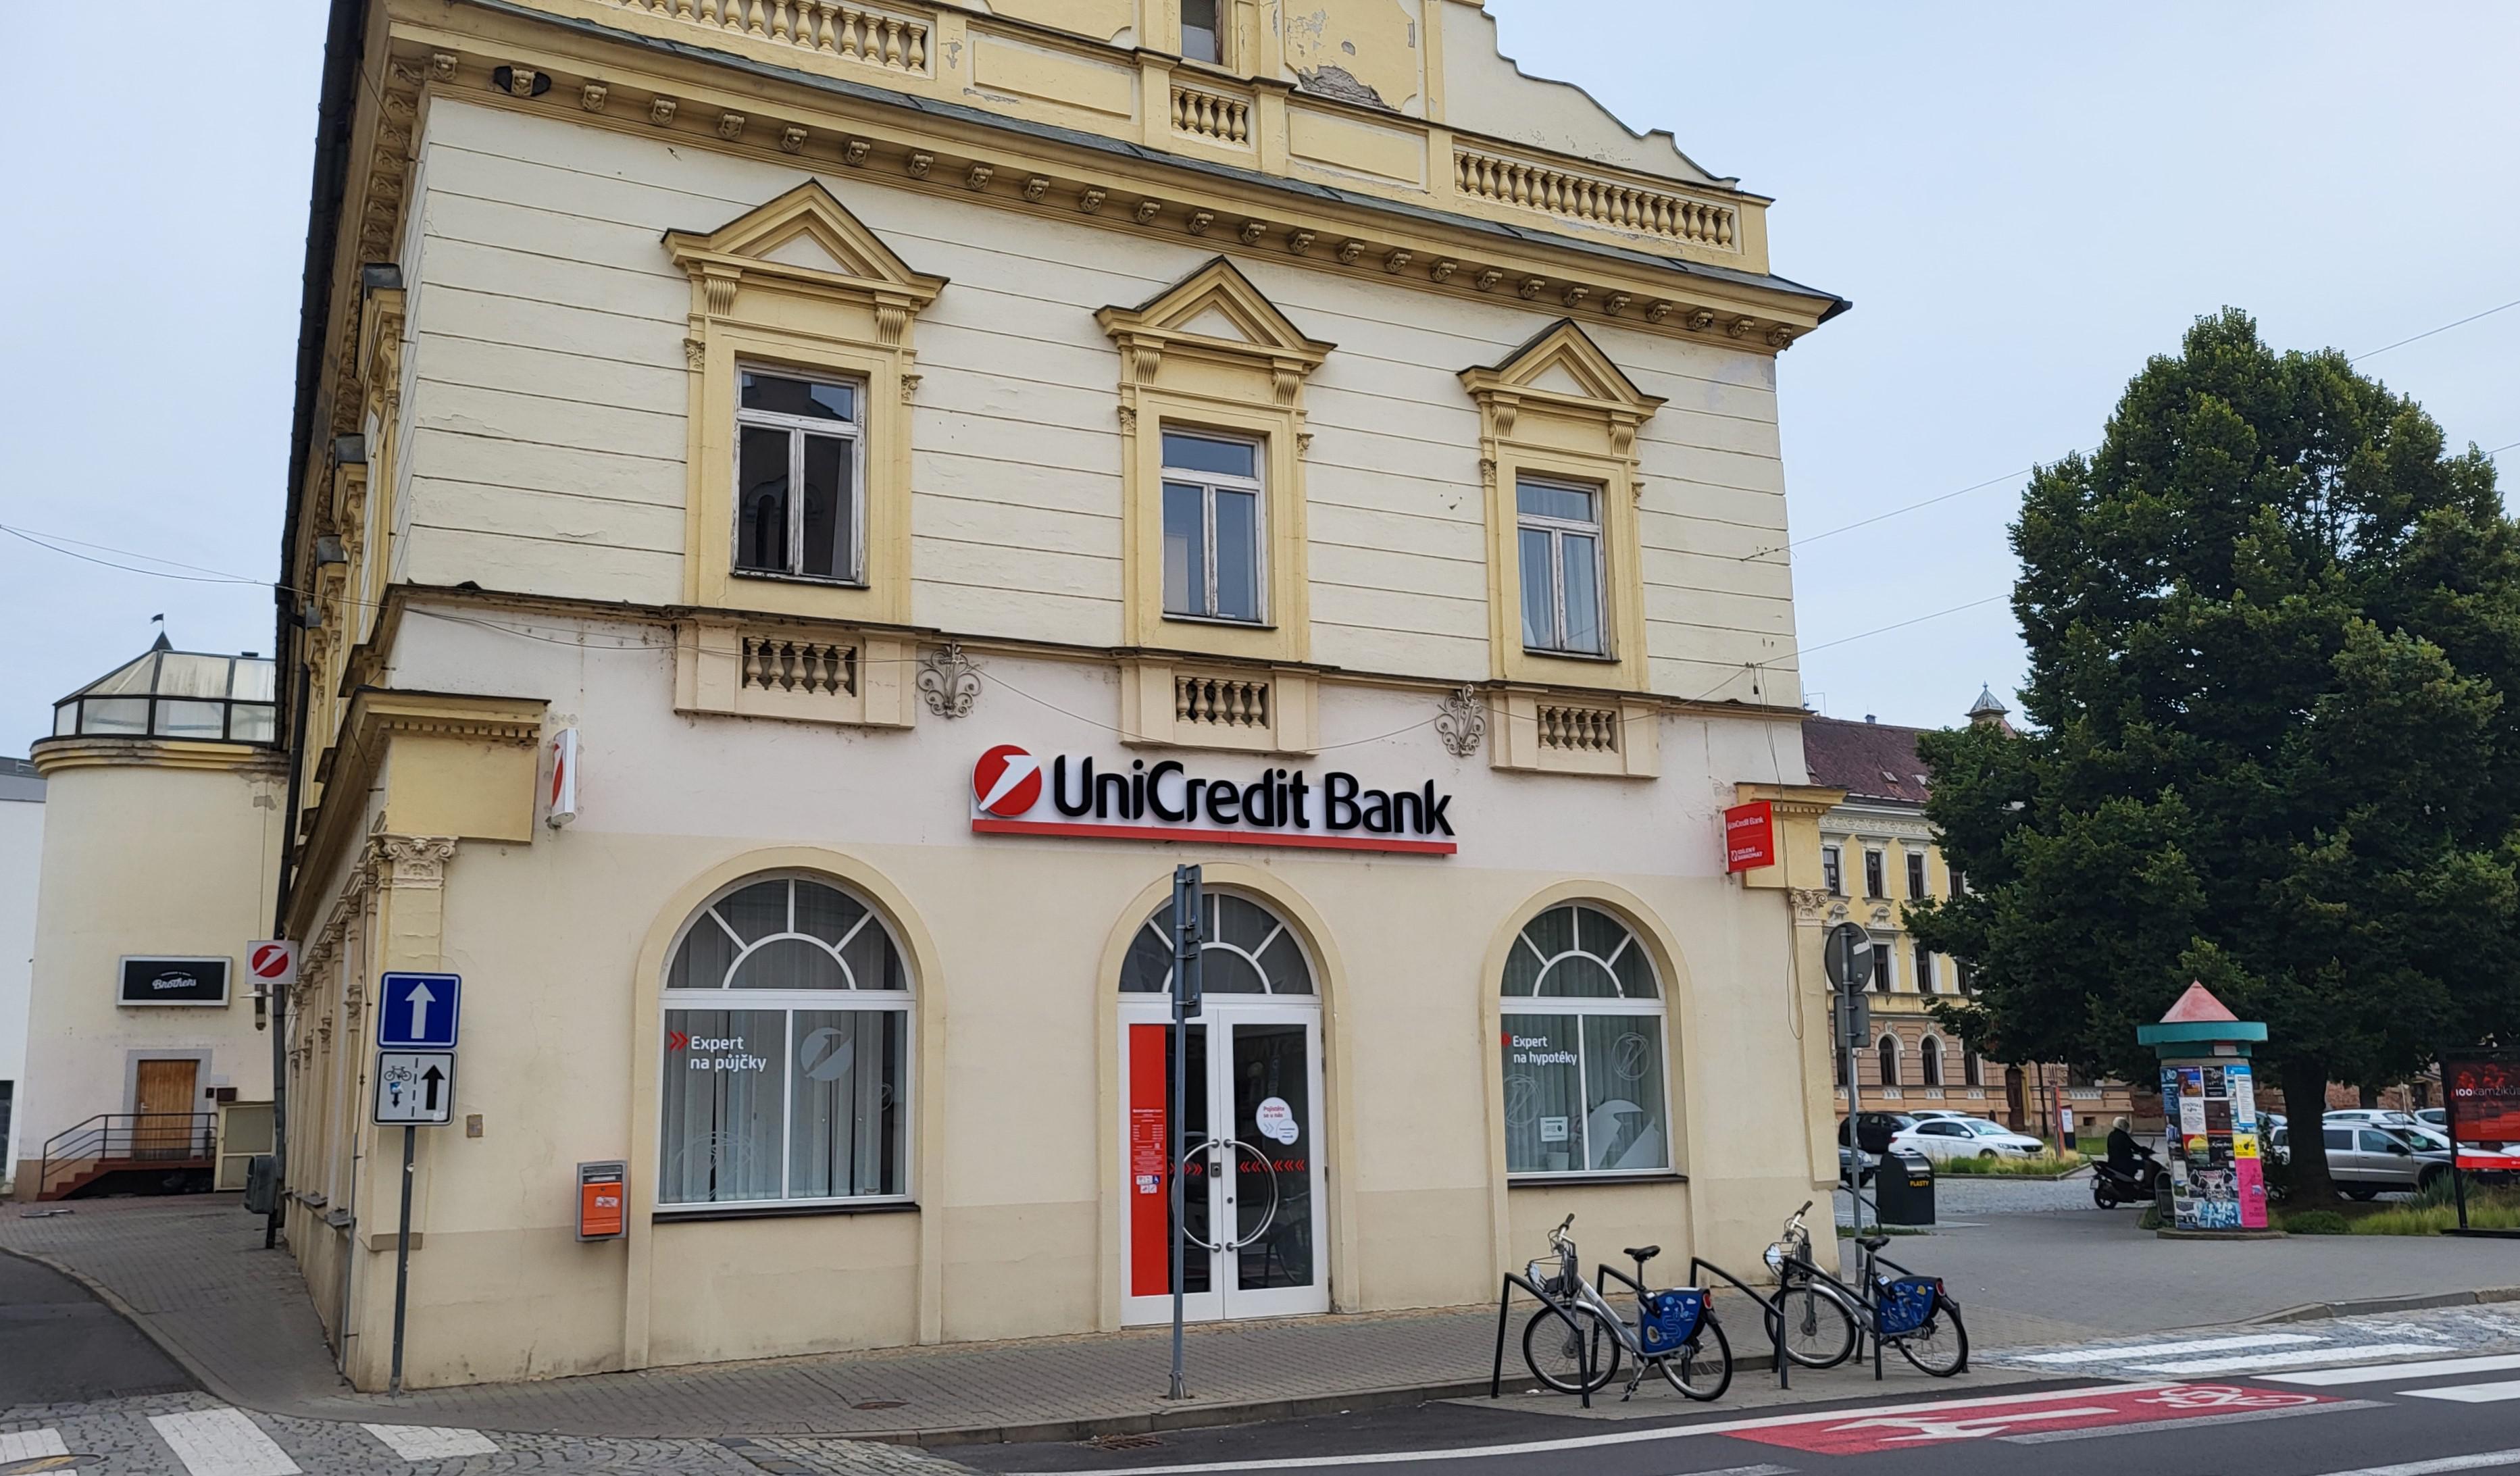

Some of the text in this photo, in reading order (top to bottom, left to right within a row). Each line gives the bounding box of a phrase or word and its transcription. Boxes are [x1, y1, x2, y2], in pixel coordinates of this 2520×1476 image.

[1054, 755, 1455, 836] UniCredit Bank
[152, 977, 197, 989] Brothers
[691, 1036, 745, 1053] Expert
[1513, 1035, 1548, 1050] Expert
[690, 1054, 767, 1073] na půjčky
[1513, 1050, 1578, 1066] na hypotéky
